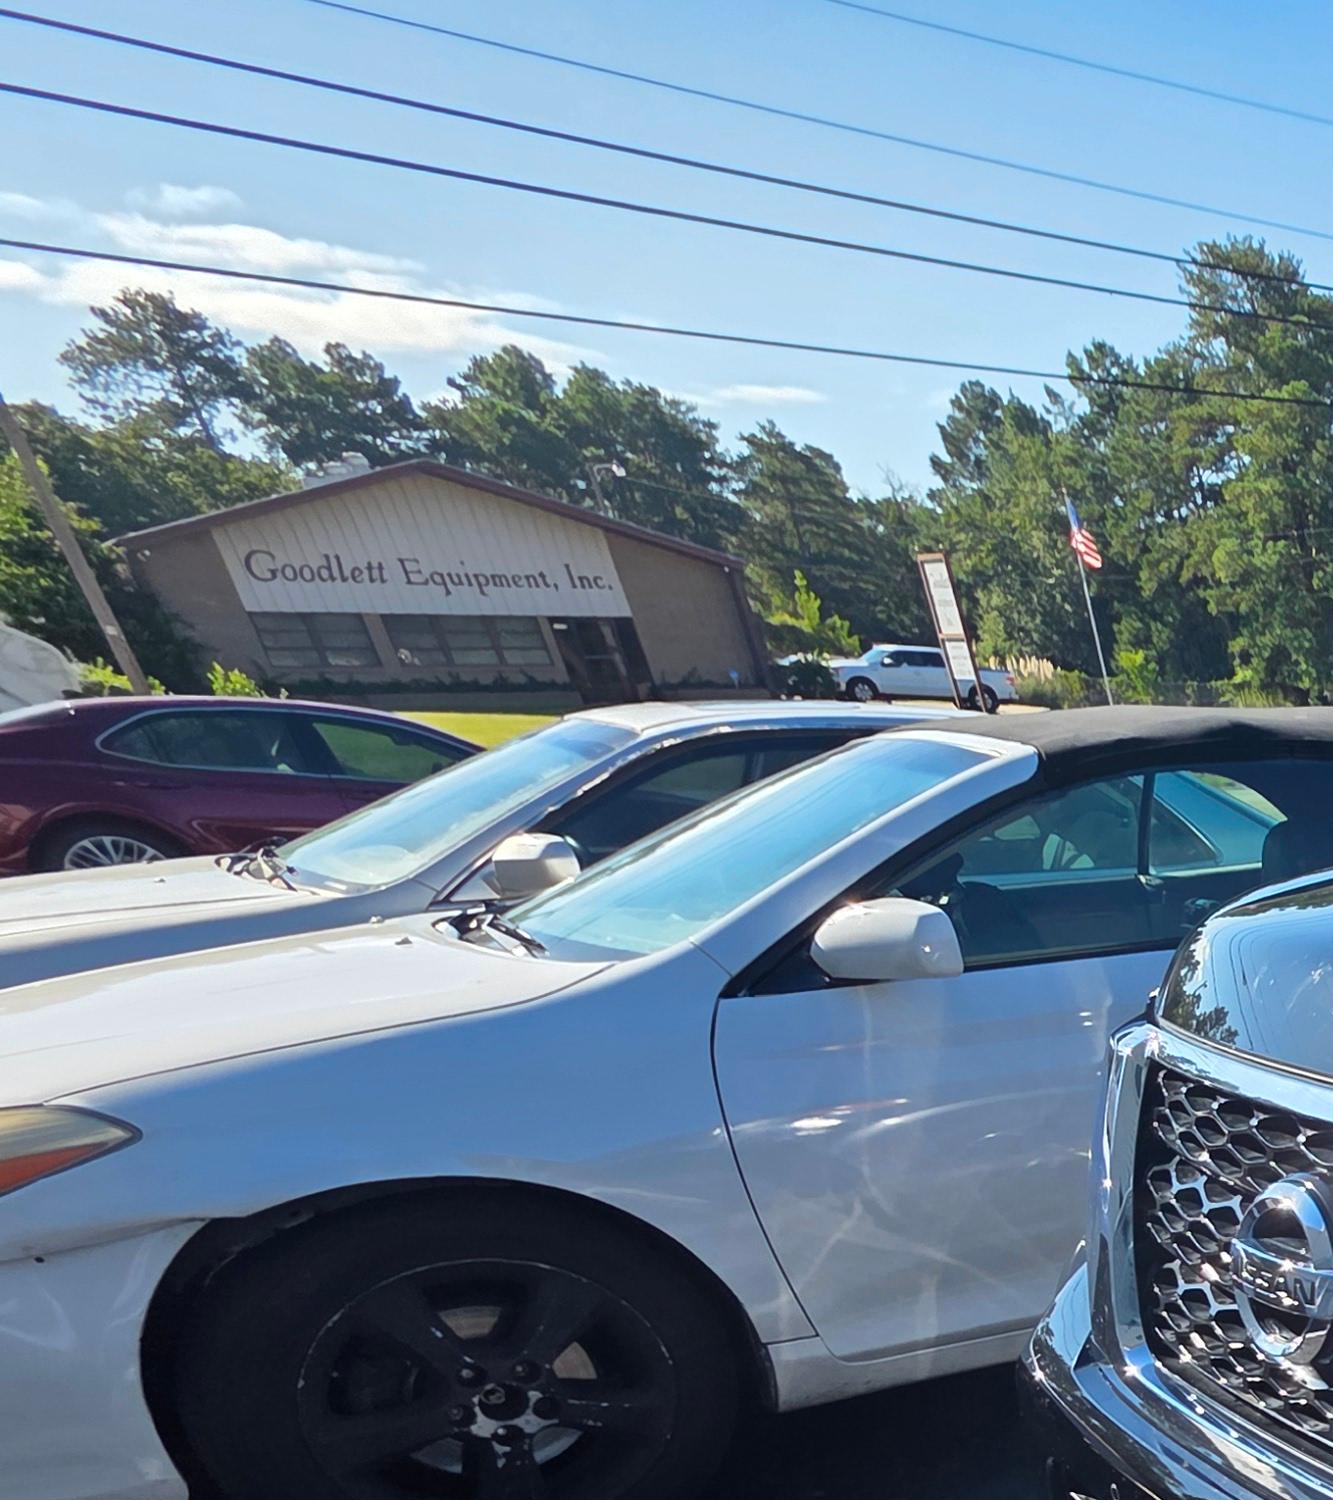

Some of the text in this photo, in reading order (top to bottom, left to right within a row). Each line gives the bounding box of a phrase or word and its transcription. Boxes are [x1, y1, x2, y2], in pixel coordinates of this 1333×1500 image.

[244, 549, 614, 596] Goodlett Equipment, Inc.
